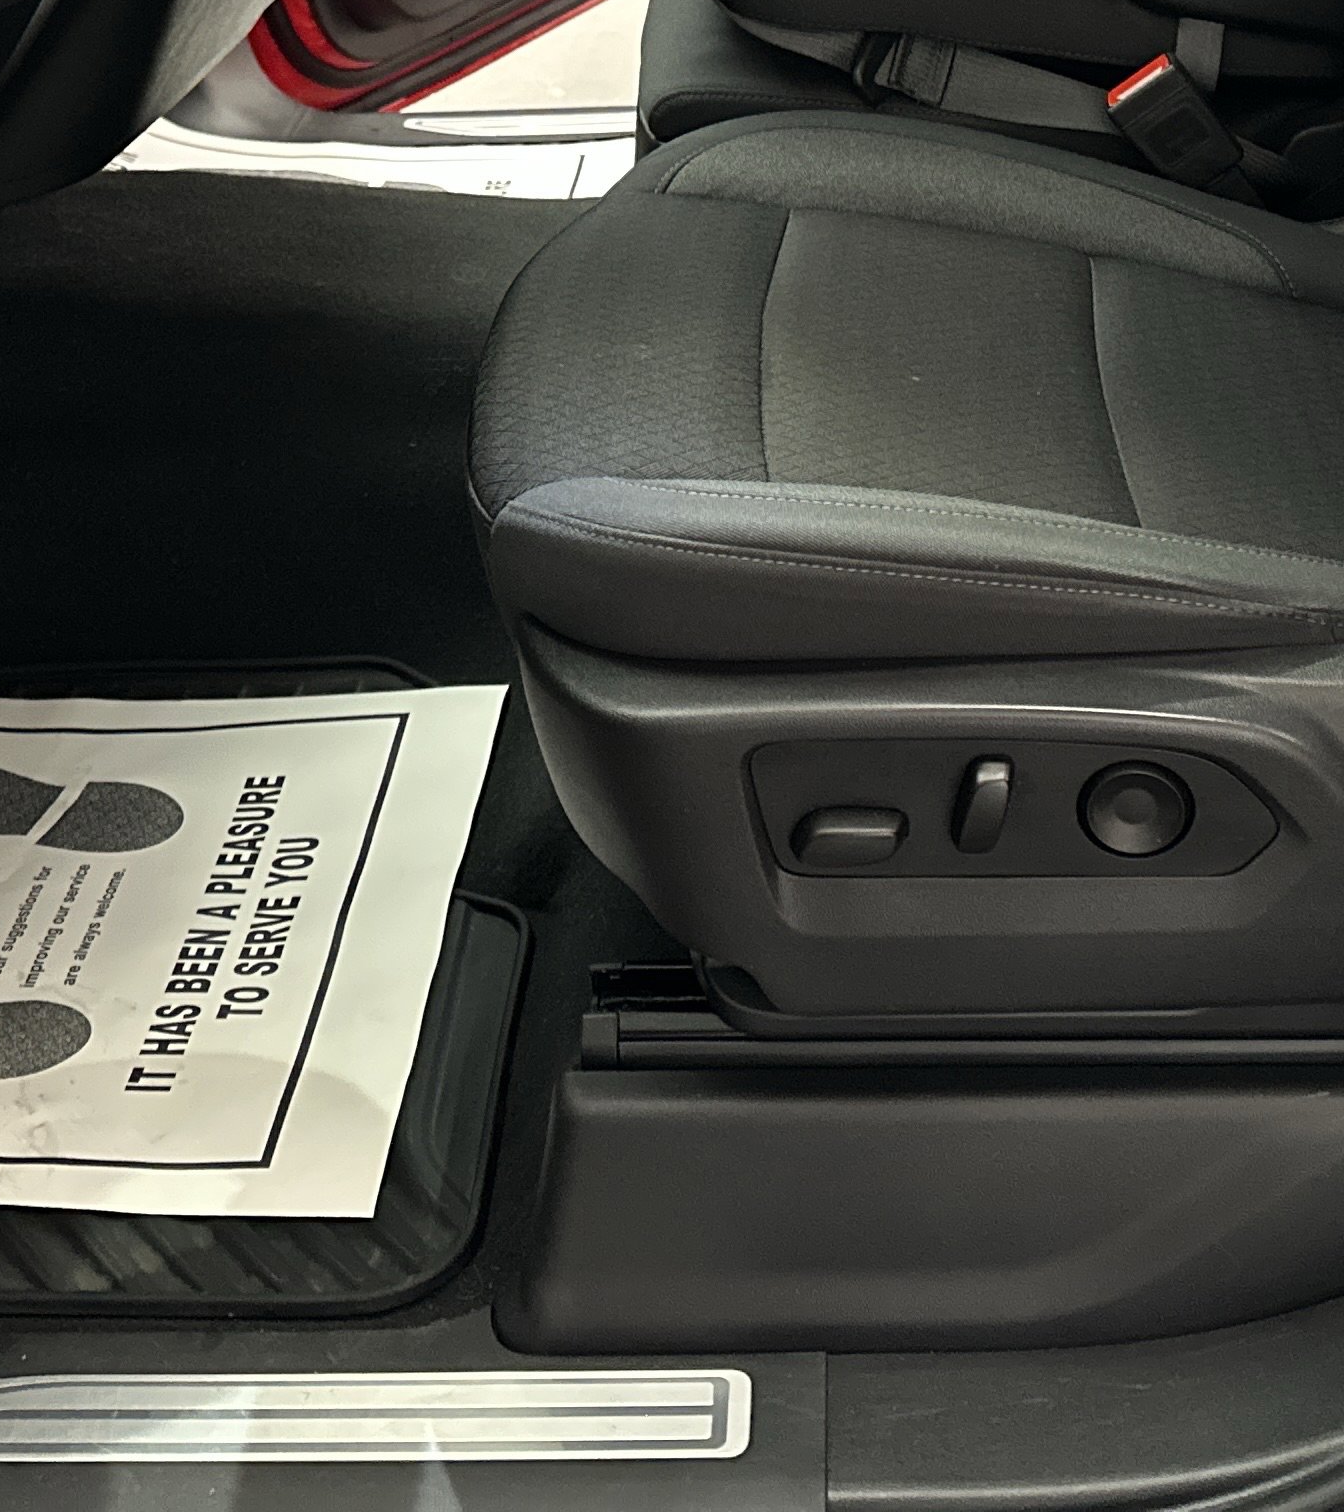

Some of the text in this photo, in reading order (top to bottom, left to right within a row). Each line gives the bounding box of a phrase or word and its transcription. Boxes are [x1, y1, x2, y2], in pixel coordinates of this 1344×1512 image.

[2, 884, 43, 952] suggestions
[33, 866, 52, 881] for
[19, 864, 90, 988] improving our service
[64, 868, 126, 986] are always welcome.
[124, 775, 286, 1092] IT HAS BEEN A PLEASURE
[216, 837, 320, 1019] TO SERVE YOU
